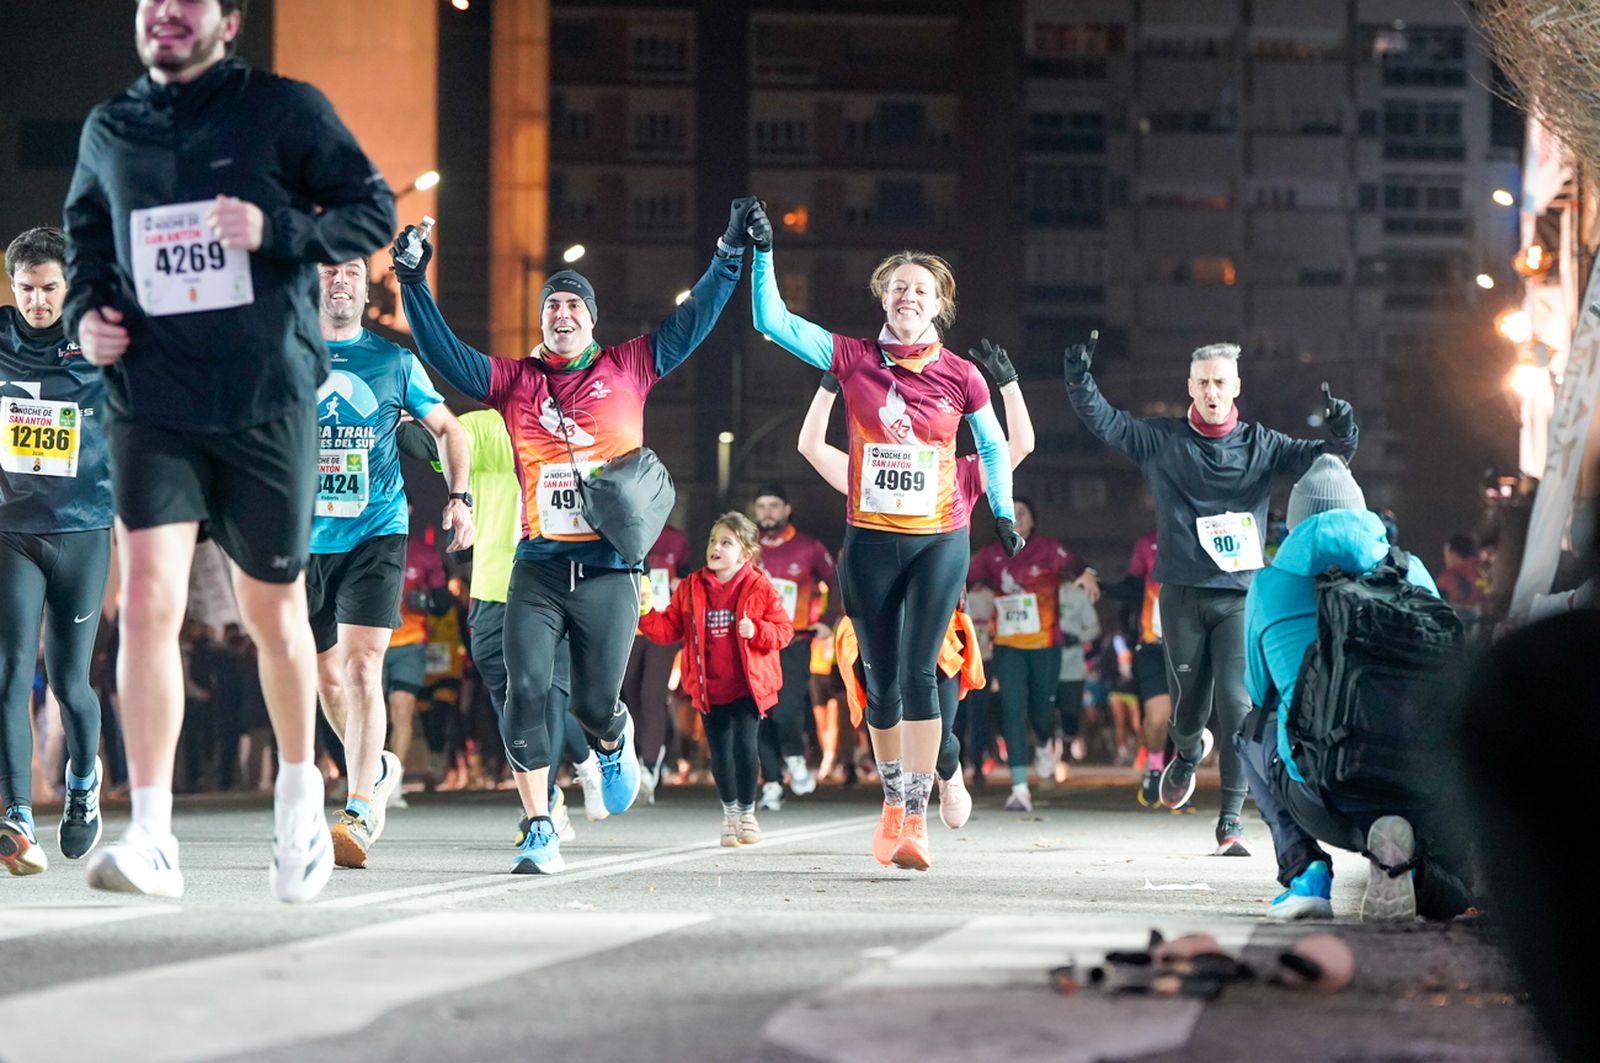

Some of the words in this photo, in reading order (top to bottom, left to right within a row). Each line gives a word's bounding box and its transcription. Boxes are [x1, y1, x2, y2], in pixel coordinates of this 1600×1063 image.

[156, 241, 225, 275] 4269
[9, 416, 24, 424] SAN
[11, 425, 70, 451] 12136
[336, 426, 375, 438] TRAIL
[334, 439, 353, 448] DEL
[355, 439, 375, 449] SUR
[543, 480, 557, 488] SAN
[874, 469, 925, 492] 4969
